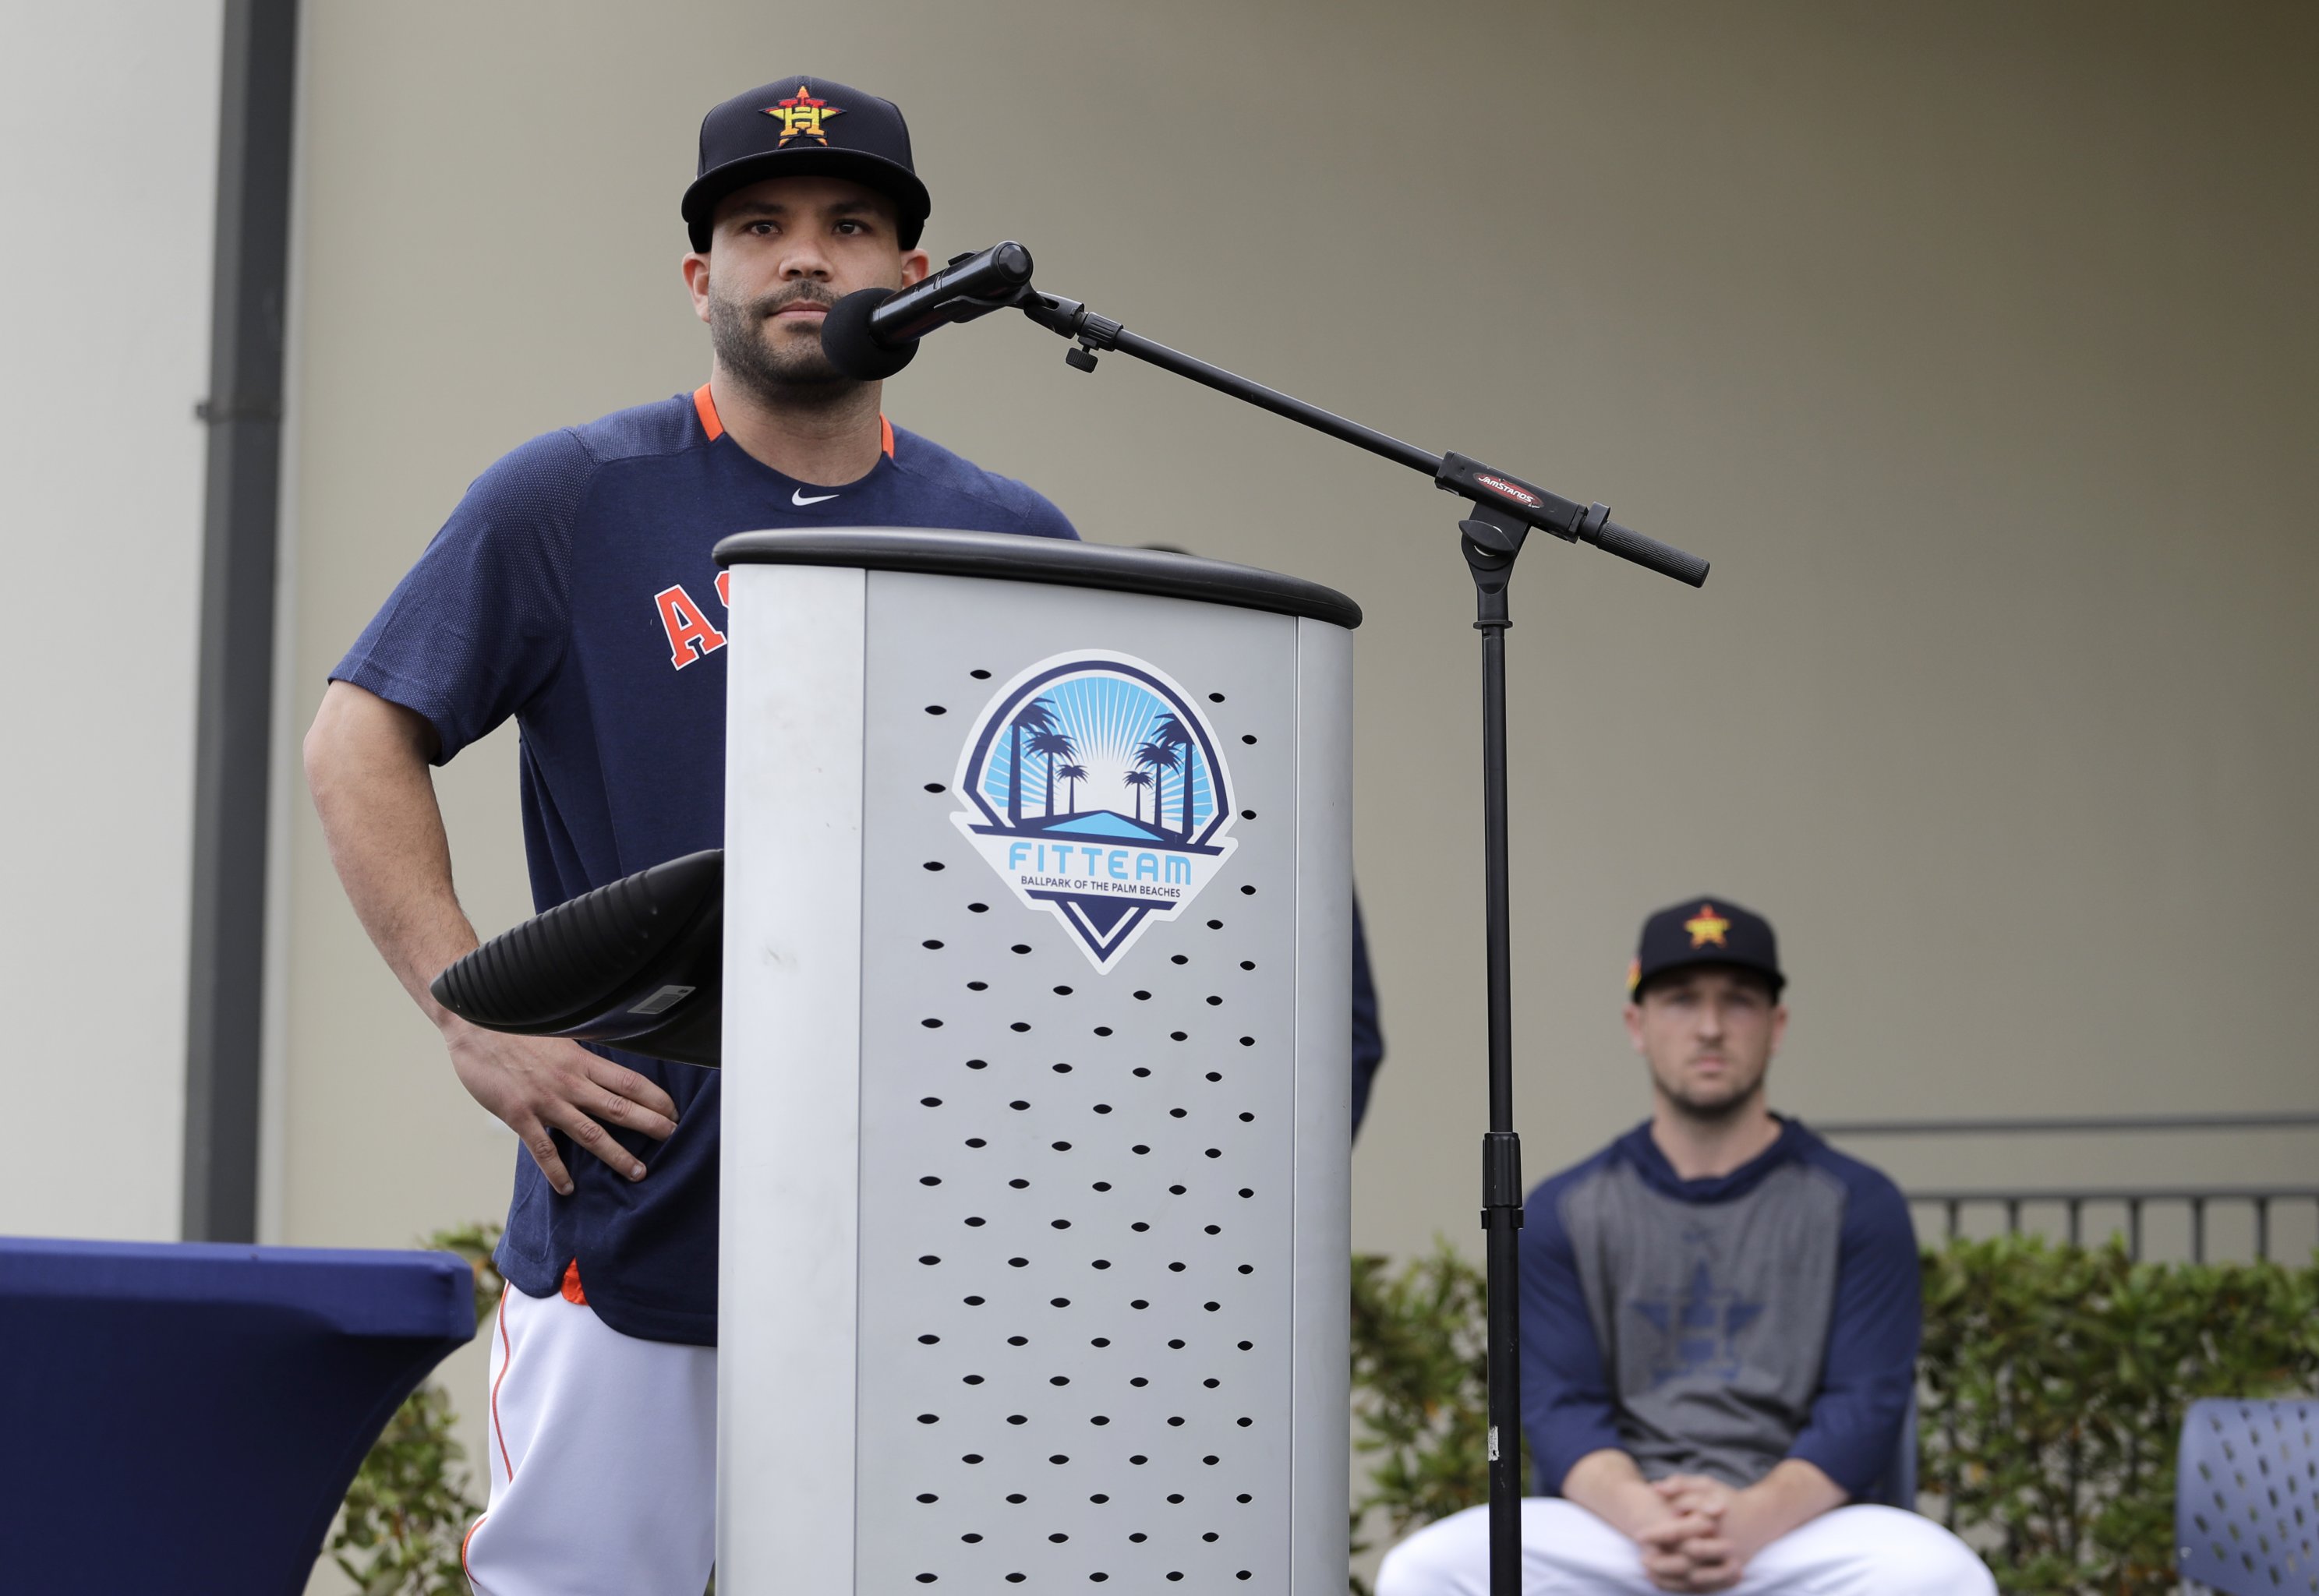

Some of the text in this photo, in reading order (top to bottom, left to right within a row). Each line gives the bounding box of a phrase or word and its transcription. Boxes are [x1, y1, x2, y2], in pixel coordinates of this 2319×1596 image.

[779, 98, 826, 137] H
[654, 570, 730, 671] A
[1009, 842, 1191, 885] FITTEAM
[1020, 876, 1181, 898] BALLPARK OF THE PALM BEACHES
